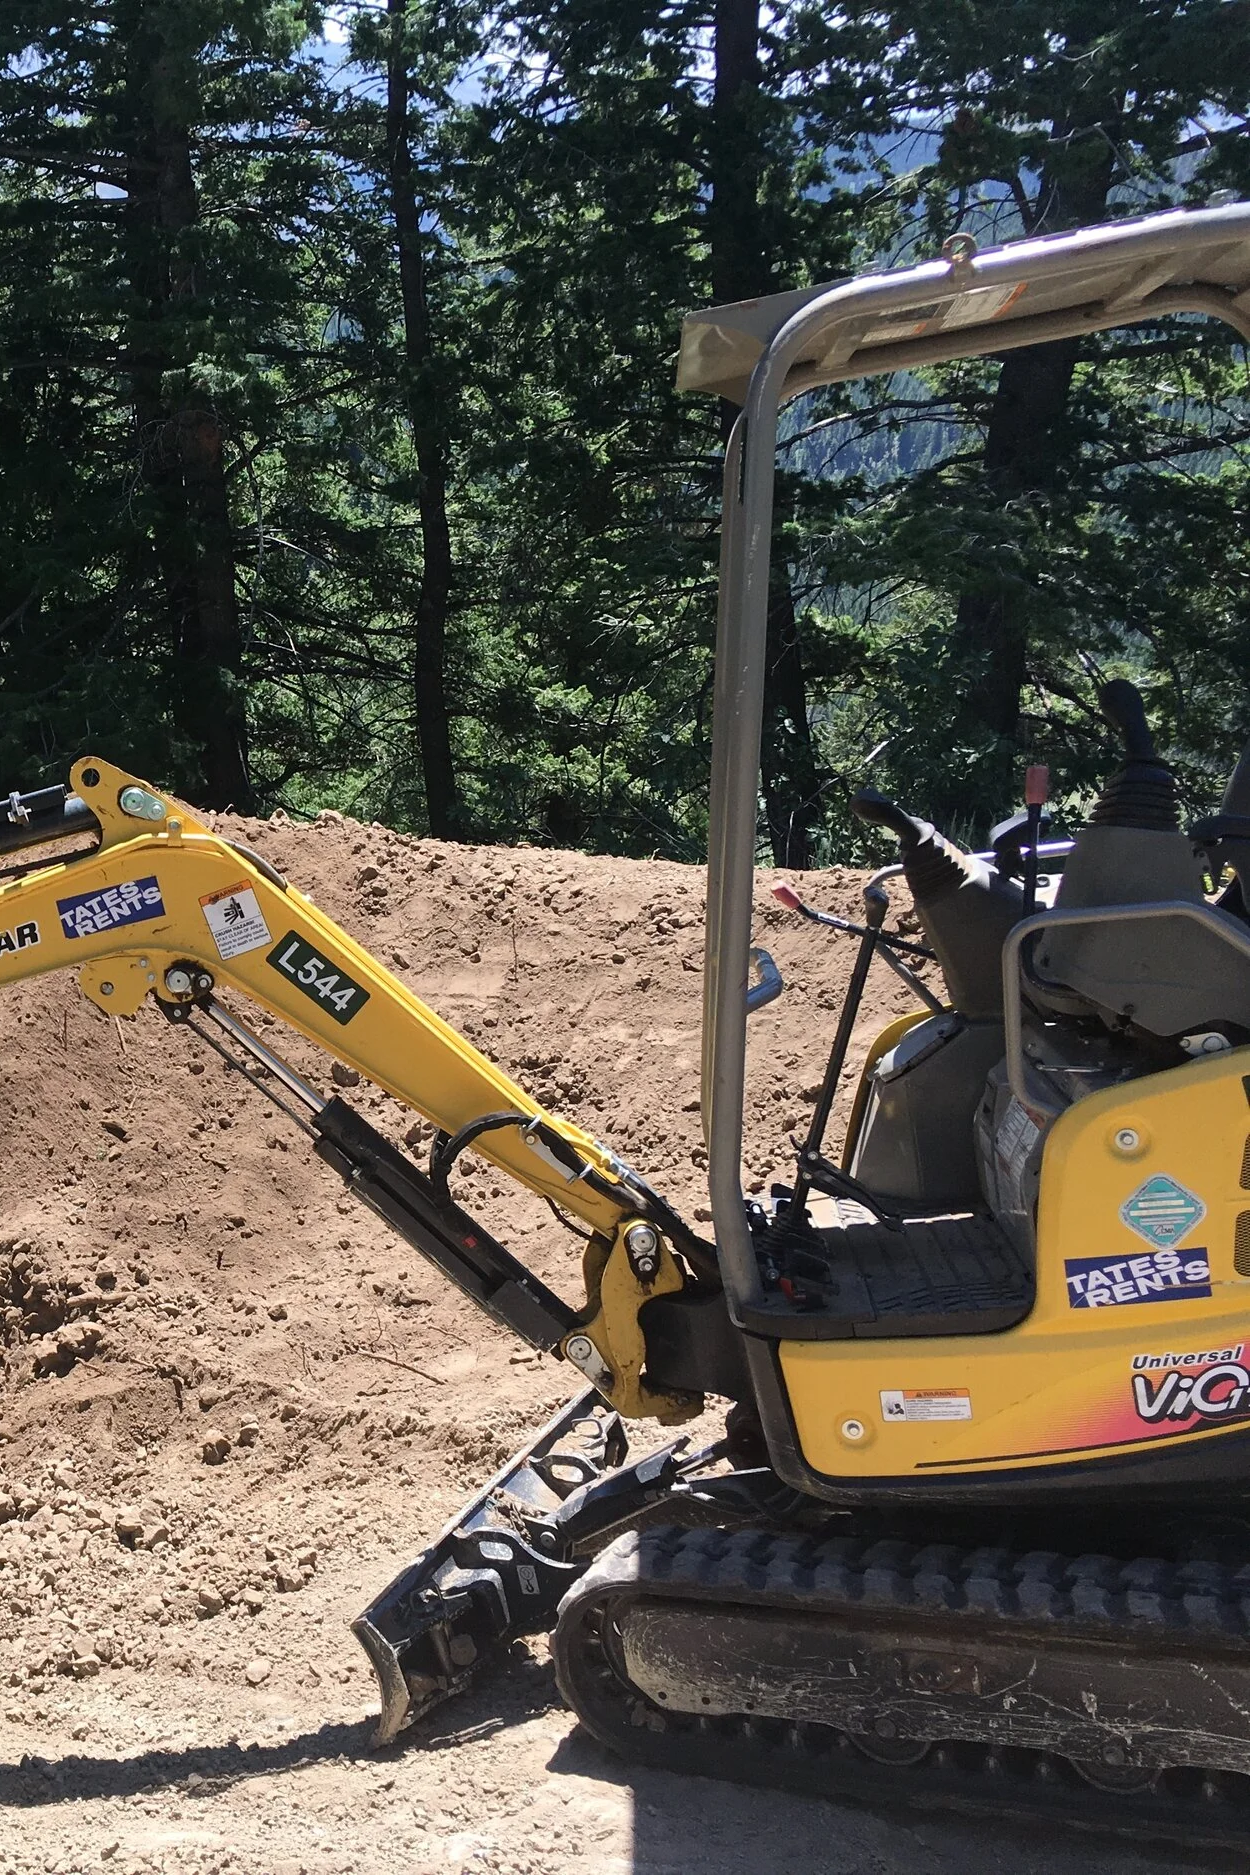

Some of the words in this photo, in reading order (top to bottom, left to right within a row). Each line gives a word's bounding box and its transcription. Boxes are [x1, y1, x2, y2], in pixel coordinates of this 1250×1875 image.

[60, 881, 139, 928] TATES
[75, 886, 162, 937] RENTS
[278, 941, 356, 1011] L544
[1066, 1250, 1181, 1294] TATES
[1085, 1260, 1210, 1308] RENTS
[1132, 1345, 1242, 1370] Universal
